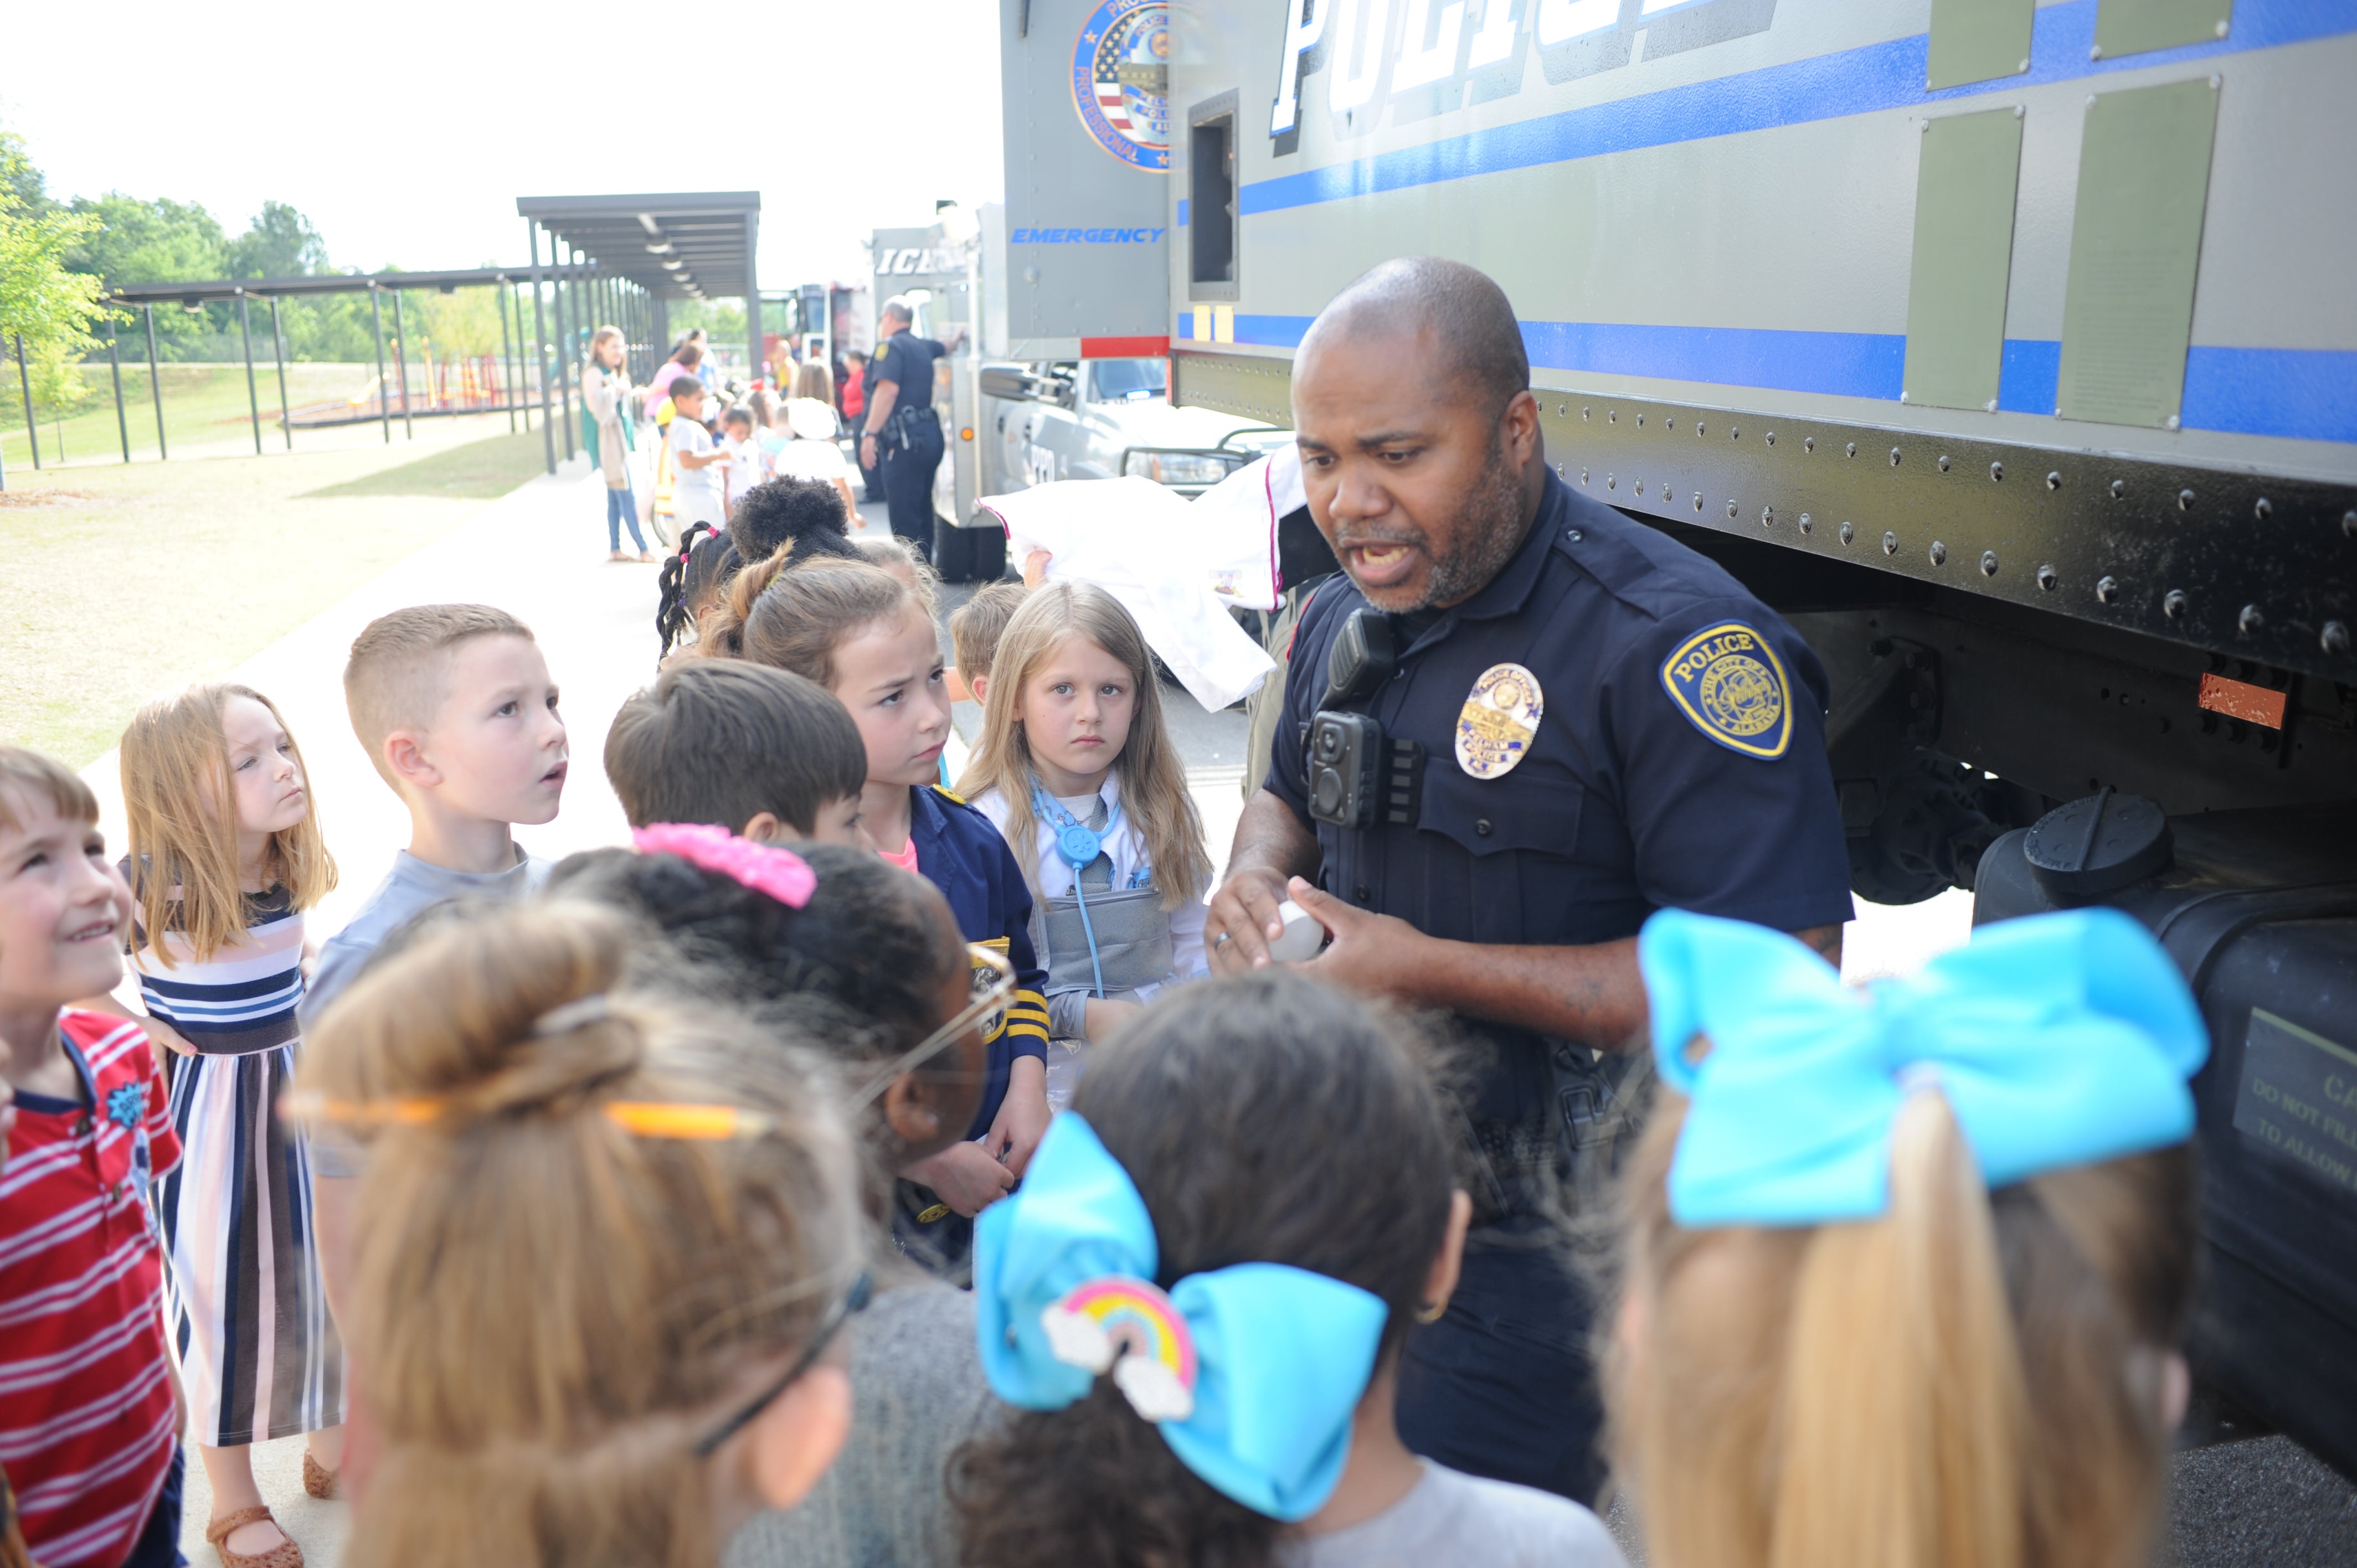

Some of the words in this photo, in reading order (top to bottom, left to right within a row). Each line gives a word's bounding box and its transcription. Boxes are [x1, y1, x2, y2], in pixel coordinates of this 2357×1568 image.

[1076, 66, 1139, 162] PROFESSIONAL
[1011, 228, 1165, 243] EMERGENCY
[1674, 634, 1754, 683] POLICE
[2252, 1077, 2279, 1102] DO
[2281, 1092, 2321, 1125] NOT
[2258, 1117, 2281, 1143] TO
[2283, 1135, 2351, 1183] ALLOW
